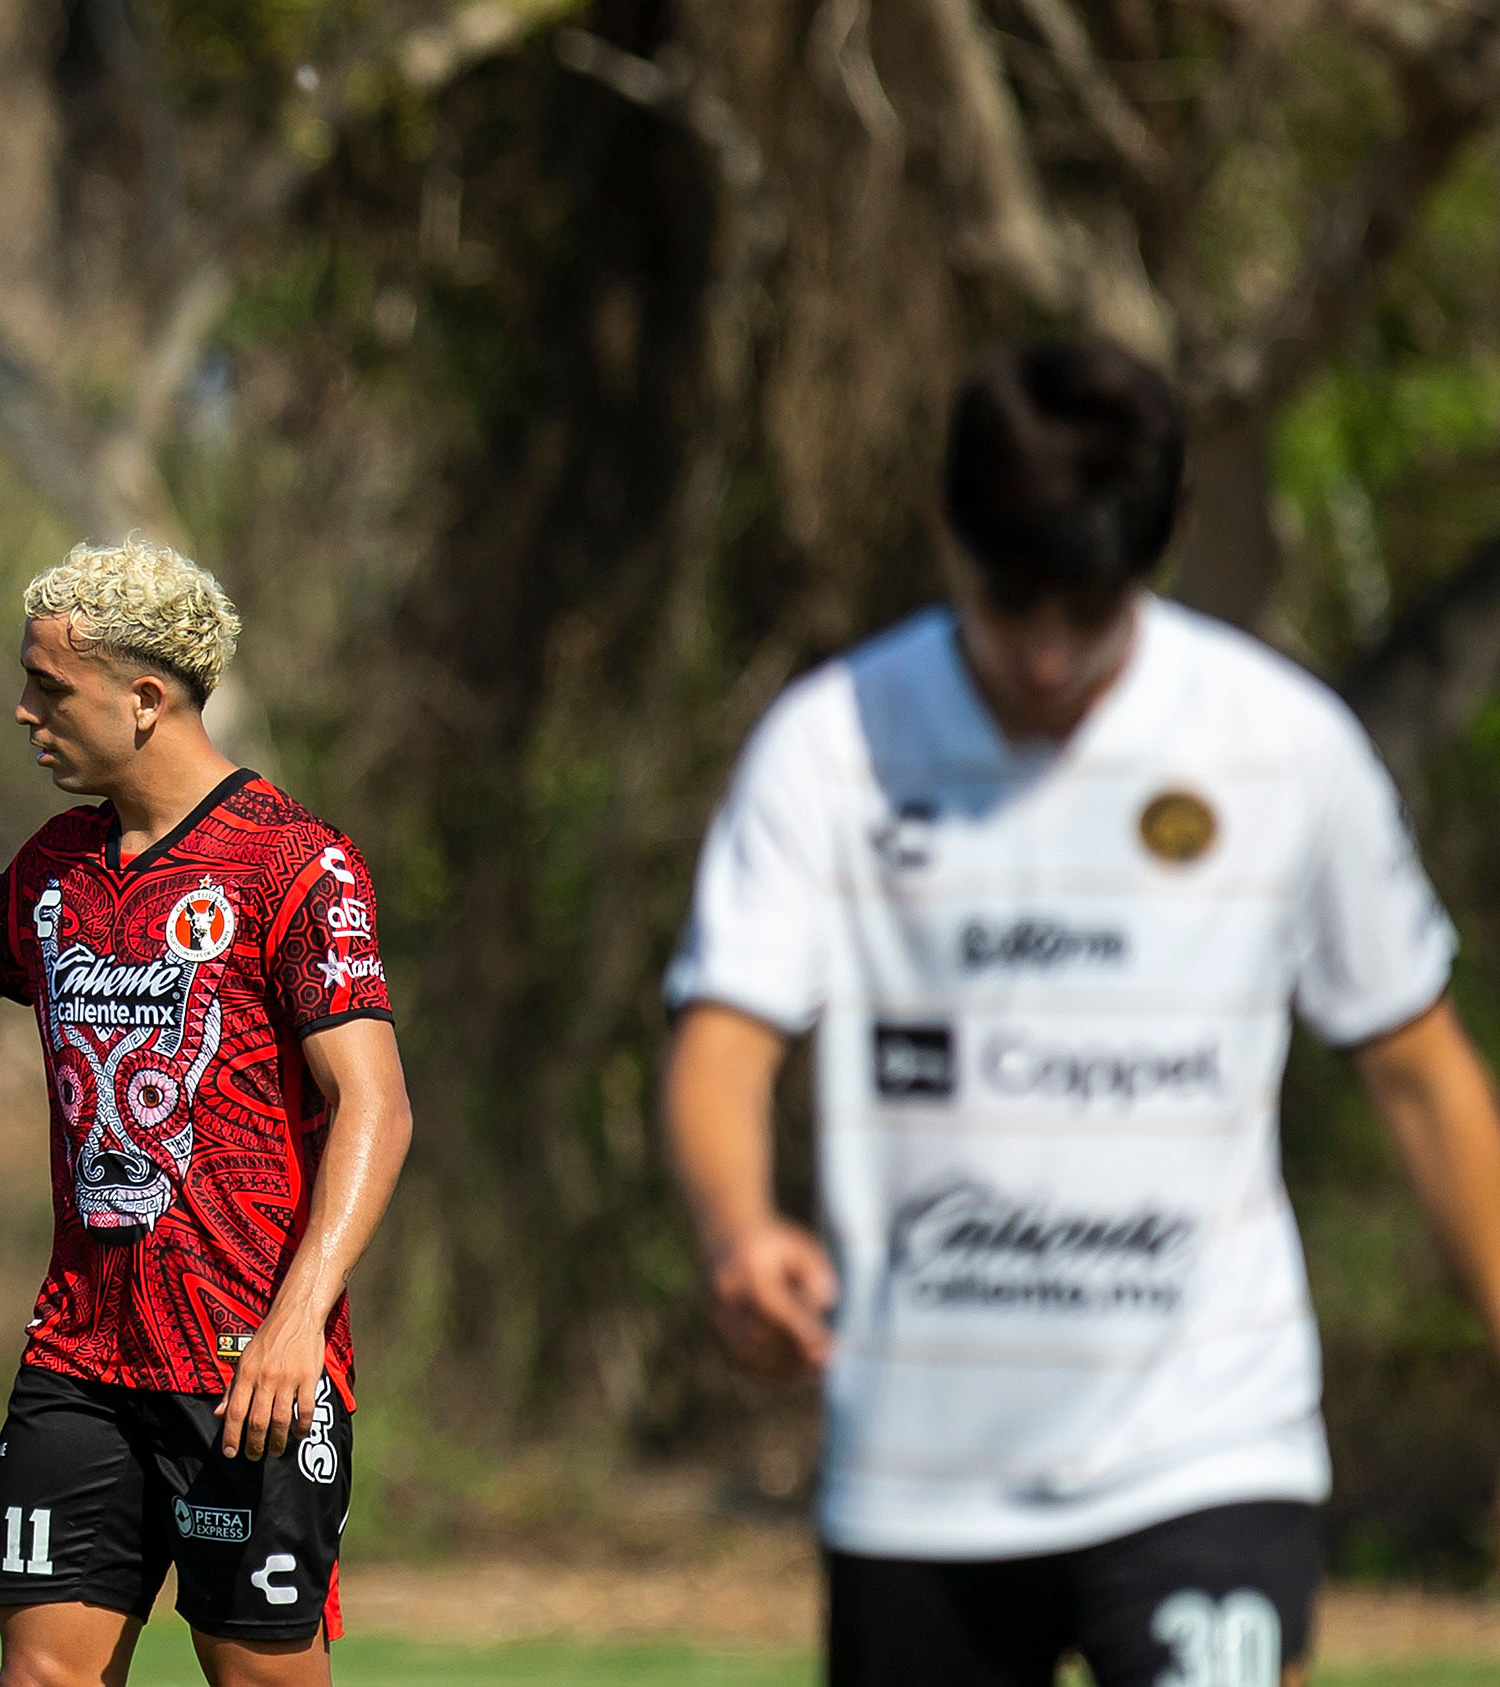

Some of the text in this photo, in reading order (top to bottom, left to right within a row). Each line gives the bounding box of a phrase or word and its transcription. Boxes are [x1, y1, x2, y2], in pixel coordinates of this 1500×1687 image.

[51, 943, 181, 1000] Caliente
[58, 997, 176, 1026] caliente.mx
[195, 1510, 243, 1528] PETSA
[196, 1525, 243, 1539] EXPRESS
[2, 1505, 53, 1575] 11
